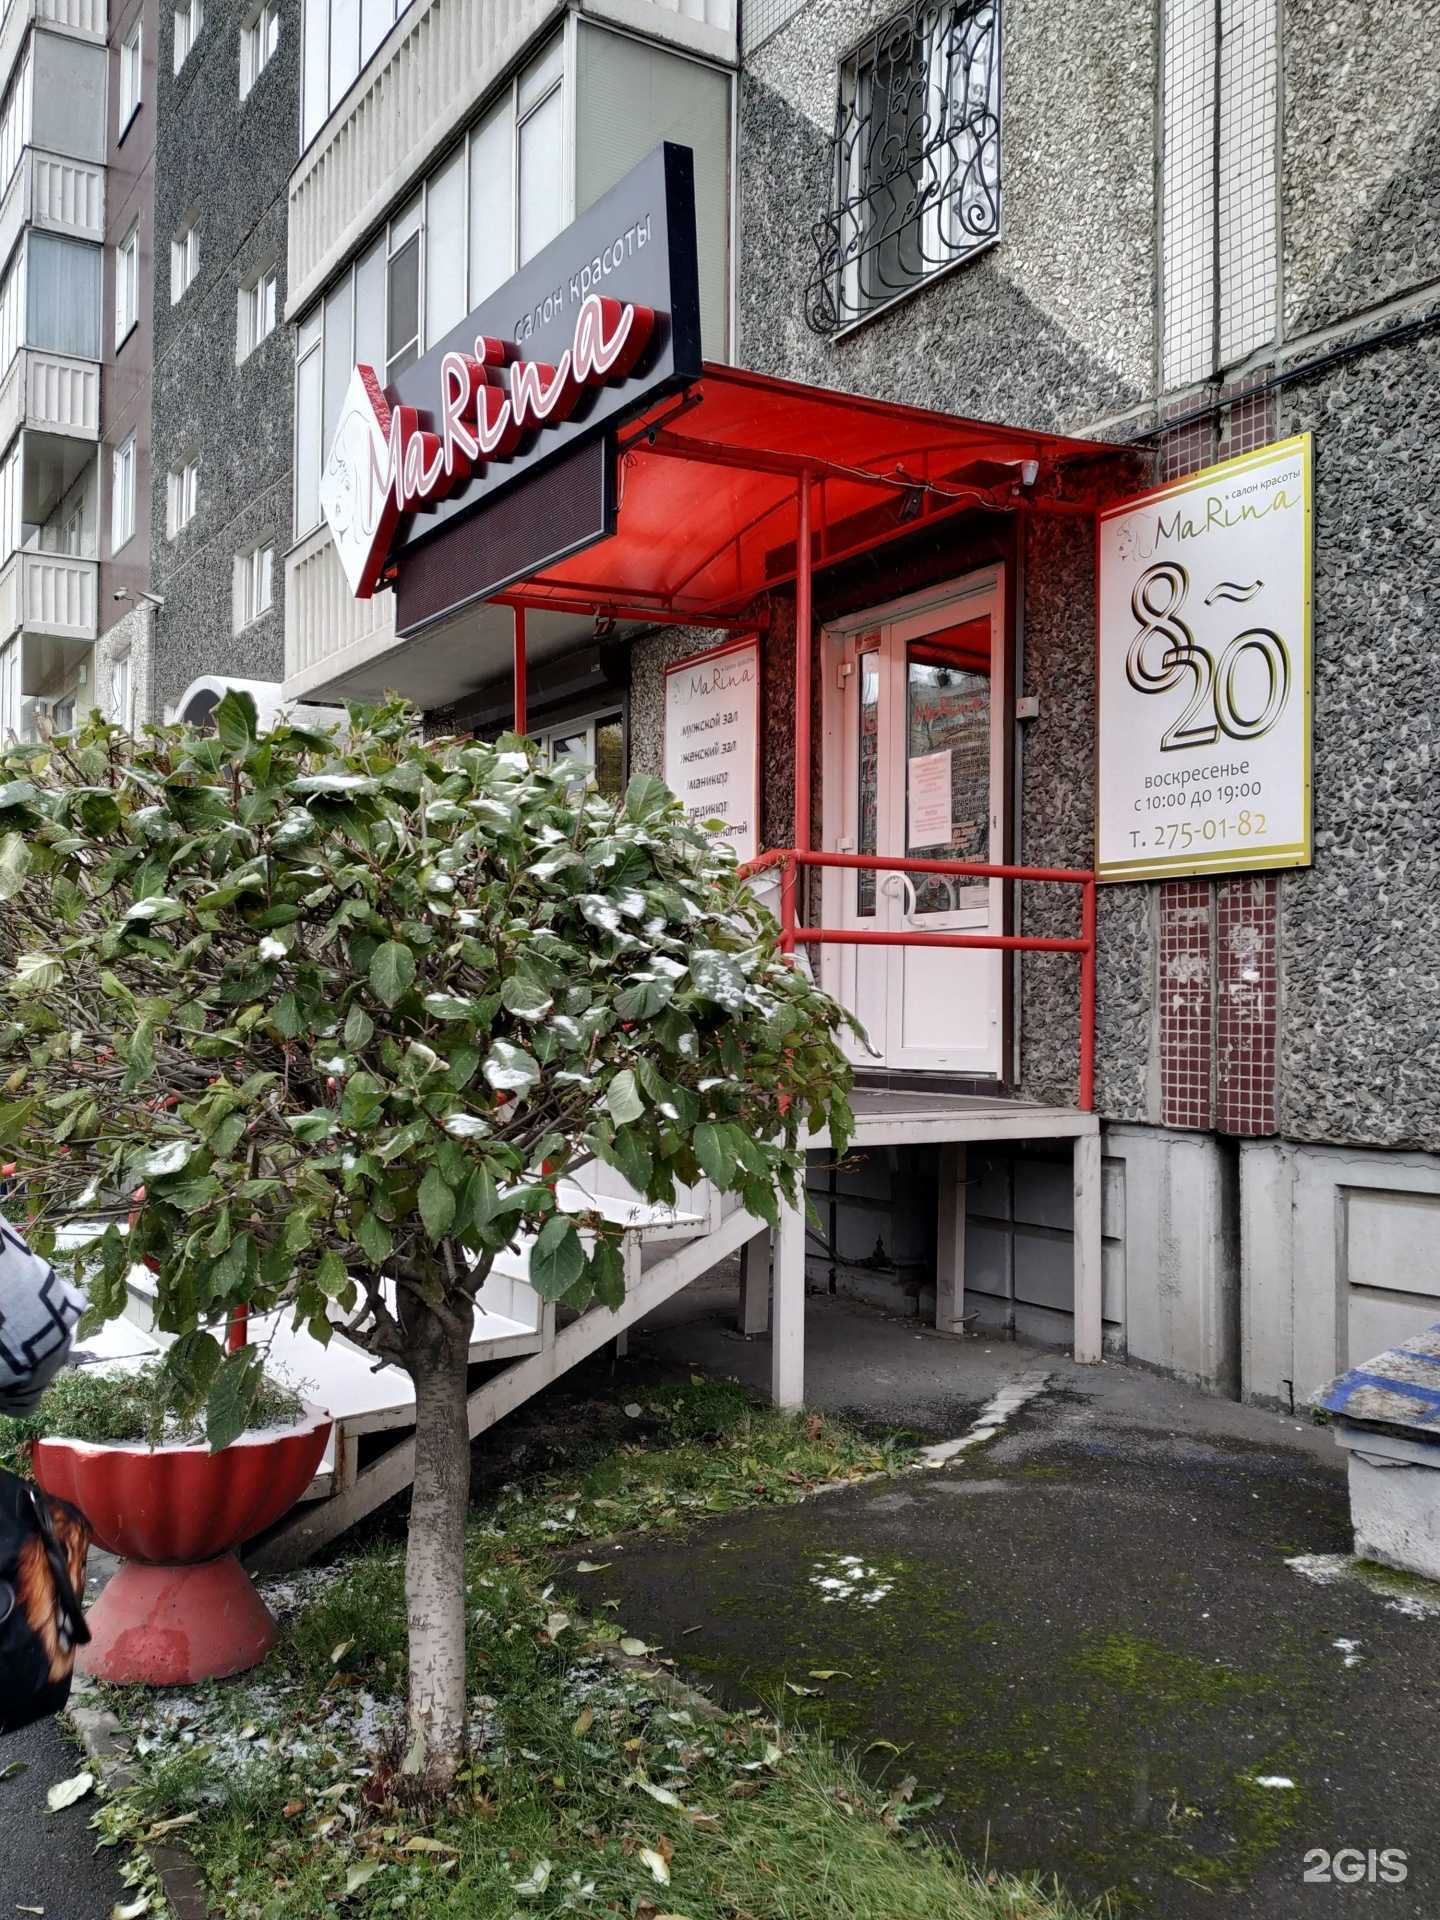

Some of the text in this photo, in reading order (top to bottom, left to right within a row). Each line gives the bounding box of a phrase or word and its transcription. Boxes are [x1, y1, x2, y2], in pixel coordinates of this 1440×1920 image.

[514, 212, 652, 346] салон красоты
[365, 293, 638, 526] MaRina
[1231, 469, 1301, 500] салон красоты
[1154, 490, 1302, 550] MaRina
[689, 667, 754, 698] MaRina
[1160, 627, 1292, 752] 20
[681, 710, 739, 739] мужской зал
[680, 739, 737, 766] женский зал
[687, 772, 729, 791] маникюр
[1144, 760, 1250, 789] воскресенье
[1147, 792, 1186, 811] 10:00
[1191, 789, 1212, 809] до
[1217, 781, 1262, 802] 19:00
[1154, 809, 1267, 850] 275-01-82
